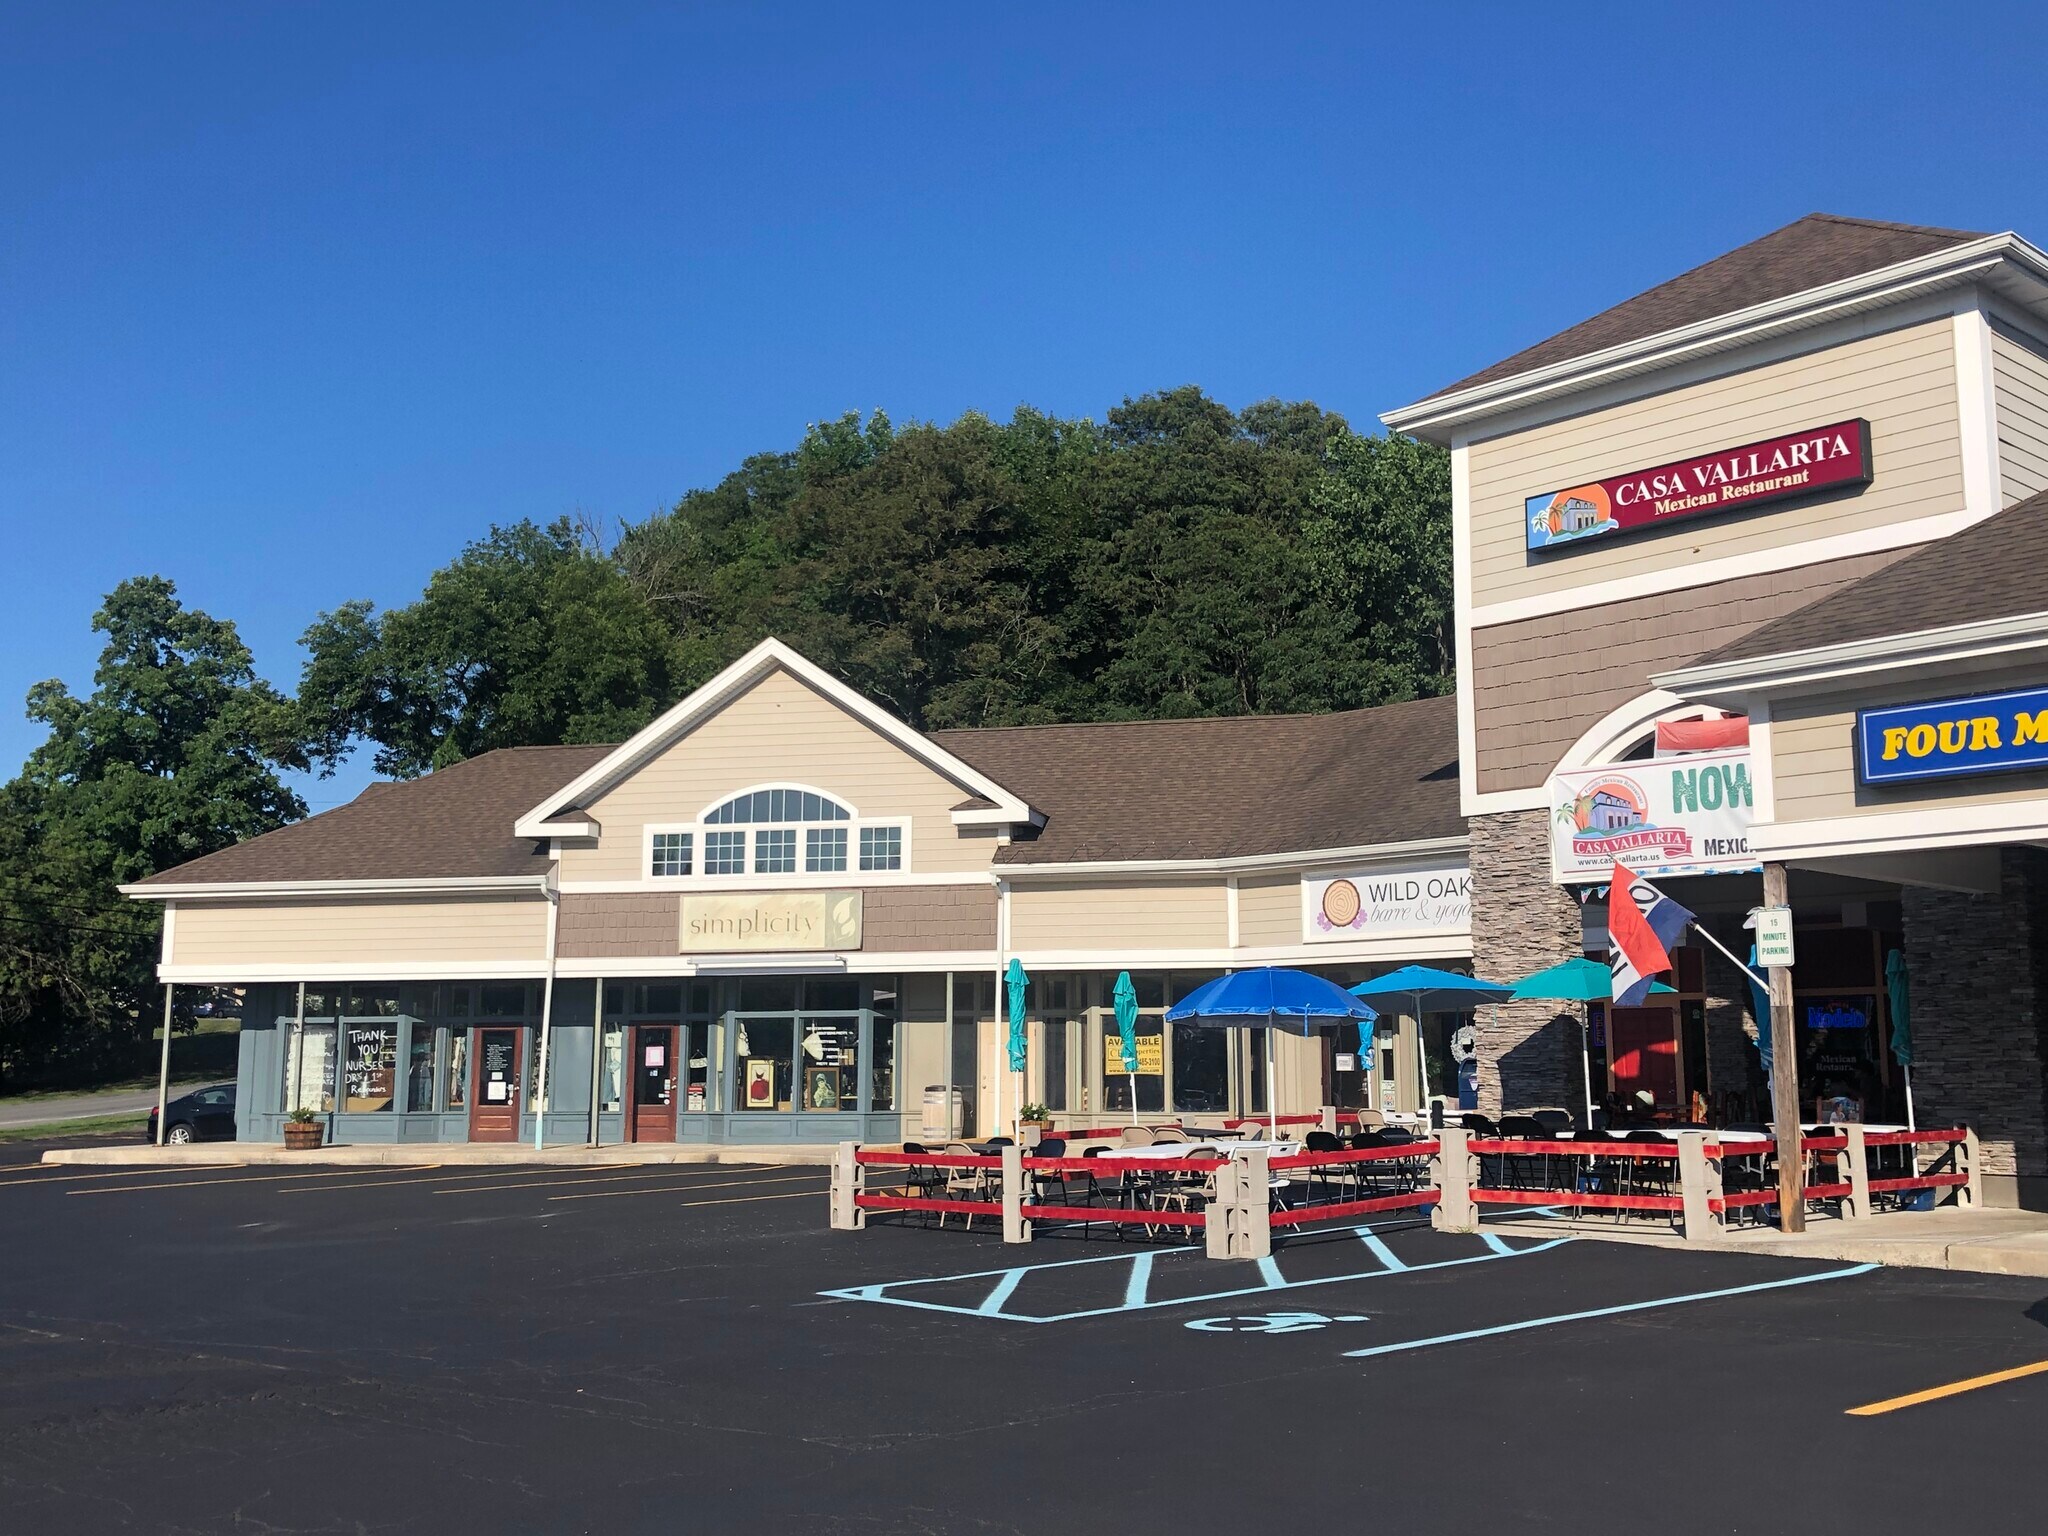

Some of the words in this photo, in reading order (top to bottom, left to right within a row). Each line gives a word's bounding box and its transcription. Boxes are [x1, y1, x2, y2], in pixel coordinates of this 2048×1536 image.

[1615, 477, 1687, 507] CASA
[1692, 434, 1851, 489] VALLARTA
[1654, 493, 1717, 516] Mexican
[1721, 469, 1810, 499] Restaurant
[1881, 716, 2002, 761] FOUR
[1672, 762, 1754, 814] NOW
[1576, 842, 1610, 854] CASA
[1611, 832, 1682, 851] VALLARTA
[1703, 837, 1749, 857] MEXIC
[1577, 853, 1660, 866] www.casaallarta.us
[1368, 881, 1420, 903] WILD
[1427, 876, 1472, 898] OAK
[1370, 904, 1411, 922] barre
[1415, 899, 1430, 921] &
[690, 909, 819, 940] simplicity
[1770, 918, 1778, 927] 15
[1762, 932, 1787, 941] MINUTE
[1762, 946, 1789, 956] PARKING
[348, 1029, 388, 1043] THANK
[1108, 1037, 1160, 1046] AVABLE
[357, 1044, 379, 1058] YOU
[1821, 1055, 1857, 1063] Mexican
